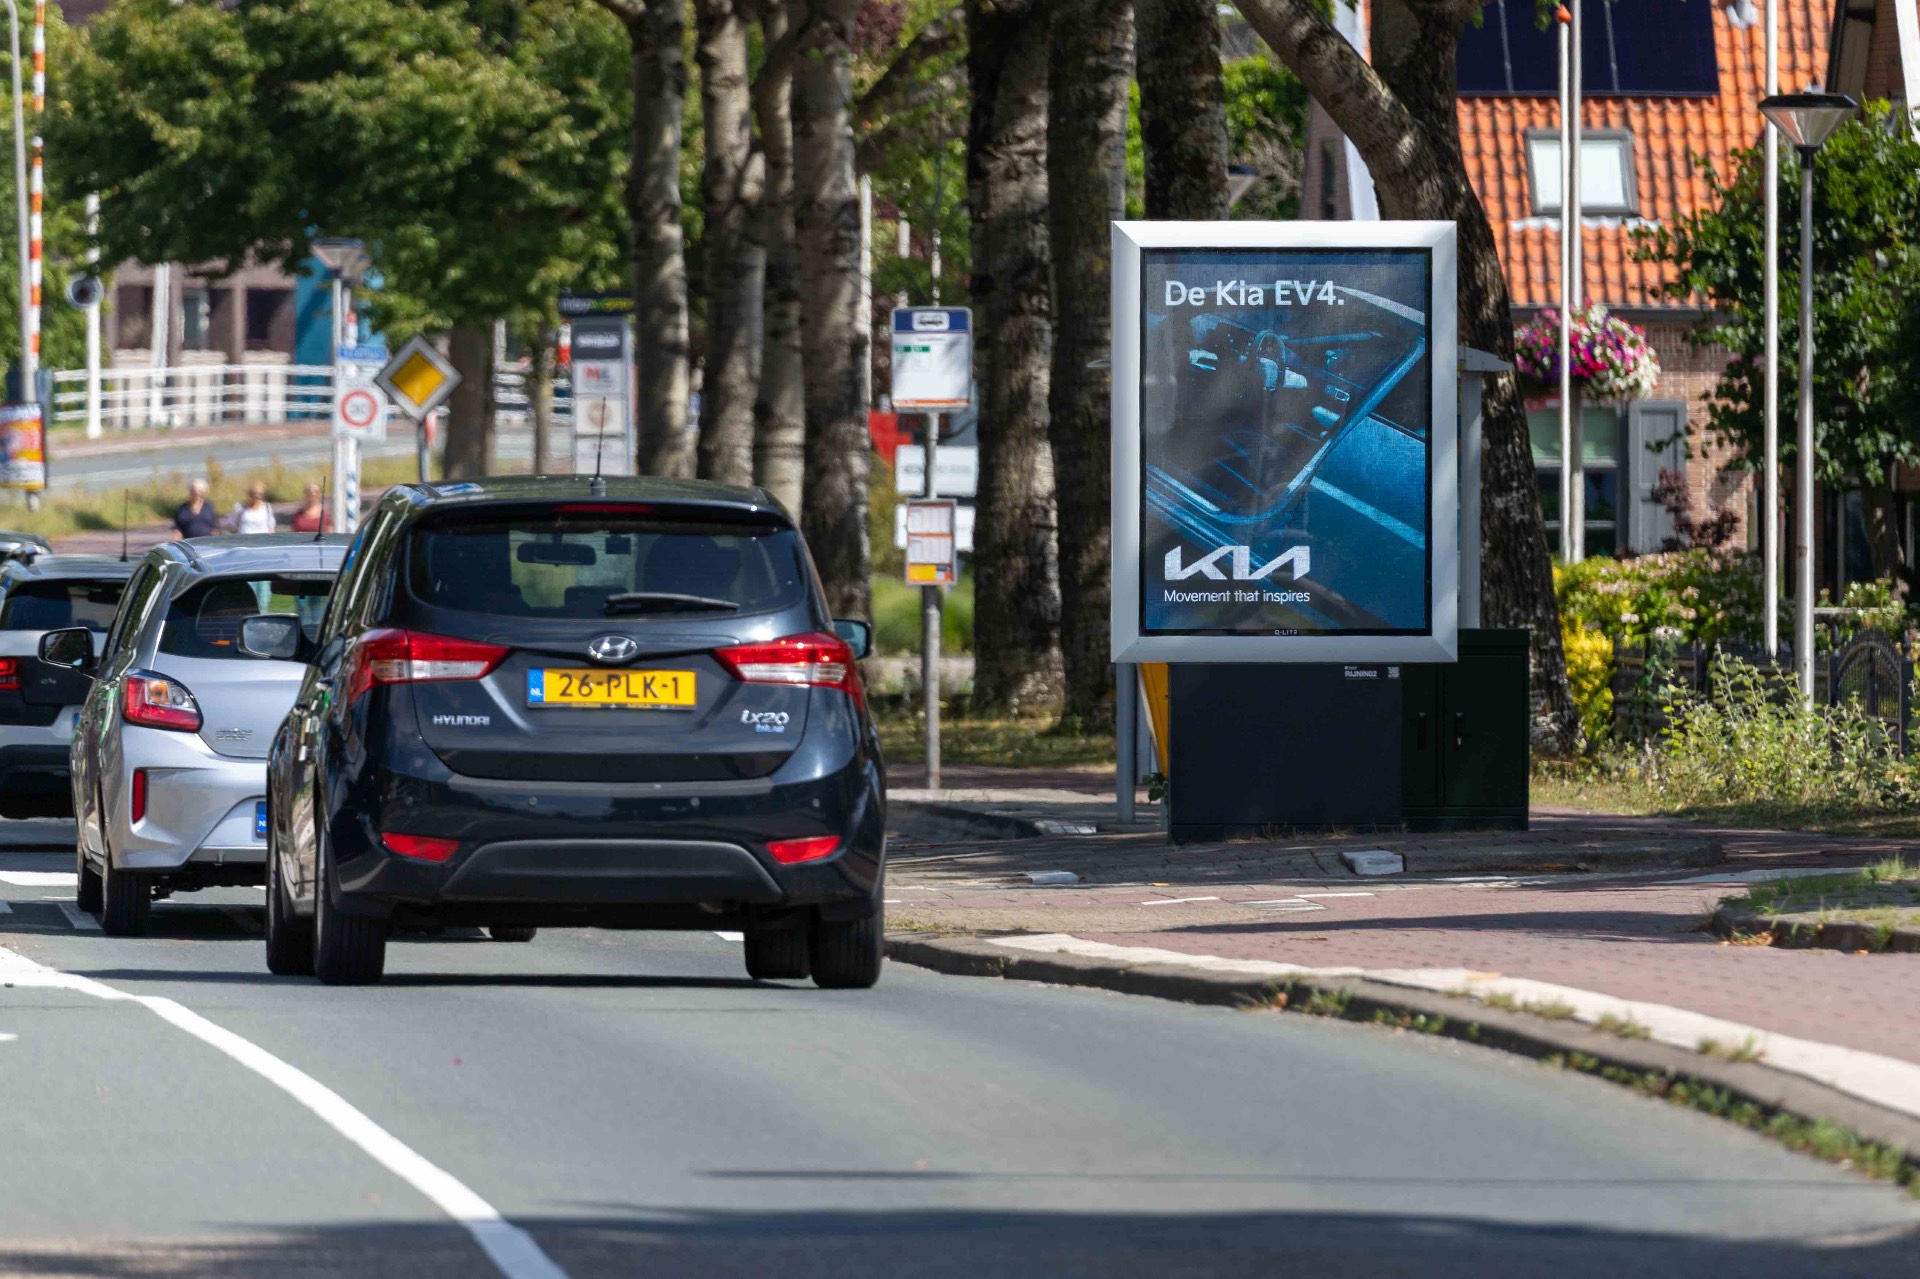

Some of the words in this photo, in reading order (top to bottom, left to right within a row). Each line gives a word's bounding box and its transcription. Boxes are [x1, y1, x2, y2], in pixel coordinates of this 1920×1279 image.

[1165, 280, 1206, 306] De
[1216, 280, 1264, 306] Kia
[1275, 280, 1345, 306] EV4.
[1164, 545, 1311, 581] KIA
[1164, 589, 1231, 602] Movement
[1234, 589, 1260, 602] that
[1263, 589, 1311, 604] inspires
[530, 688, 543, 697] NL
[558, 673, 680, 699] 26-PLK-1
[432, 714, 490, 726] HYUNDAI
[740, 709, 790, 726] ix20
